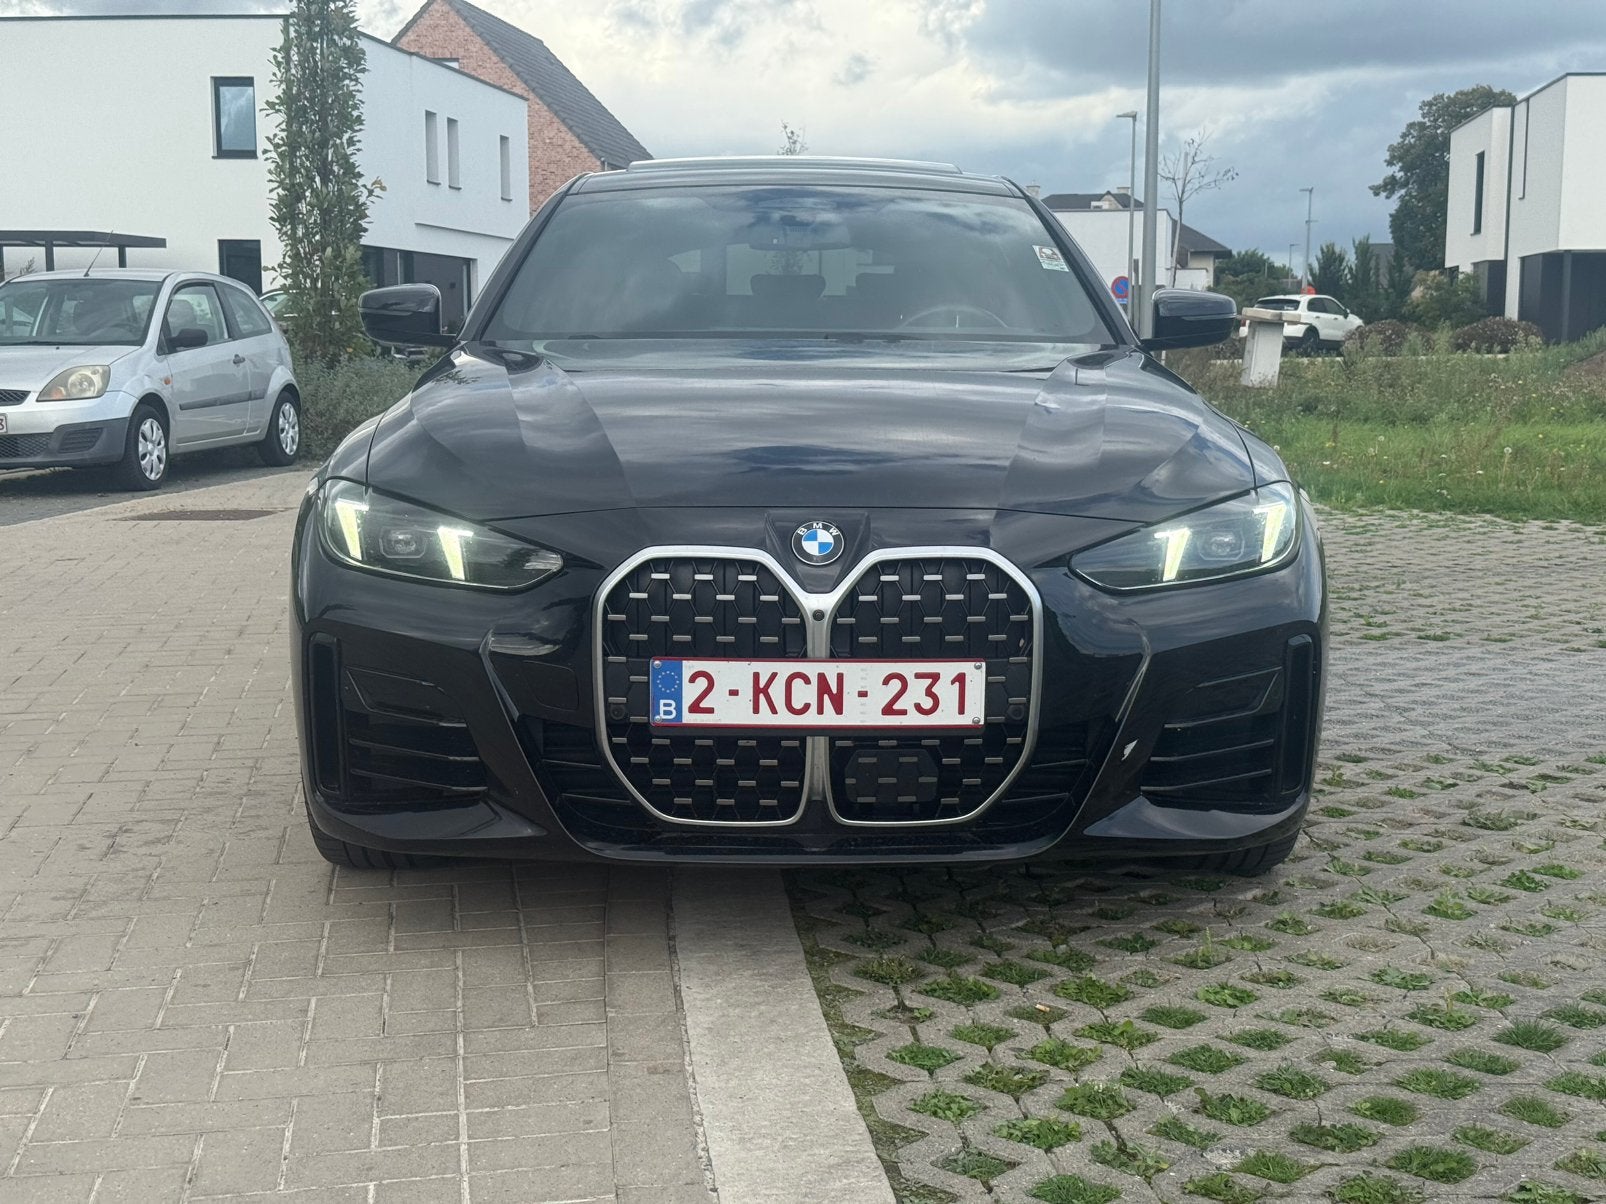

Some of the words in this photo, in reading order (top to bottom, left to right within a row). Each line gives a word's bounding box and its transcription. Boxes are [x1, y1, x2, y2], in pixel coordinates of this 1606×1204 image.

[797, 522, 840, 536] BMW
[687, 670, 966, 716] 2-KCN-231
[659, 699, 677, 719] B
